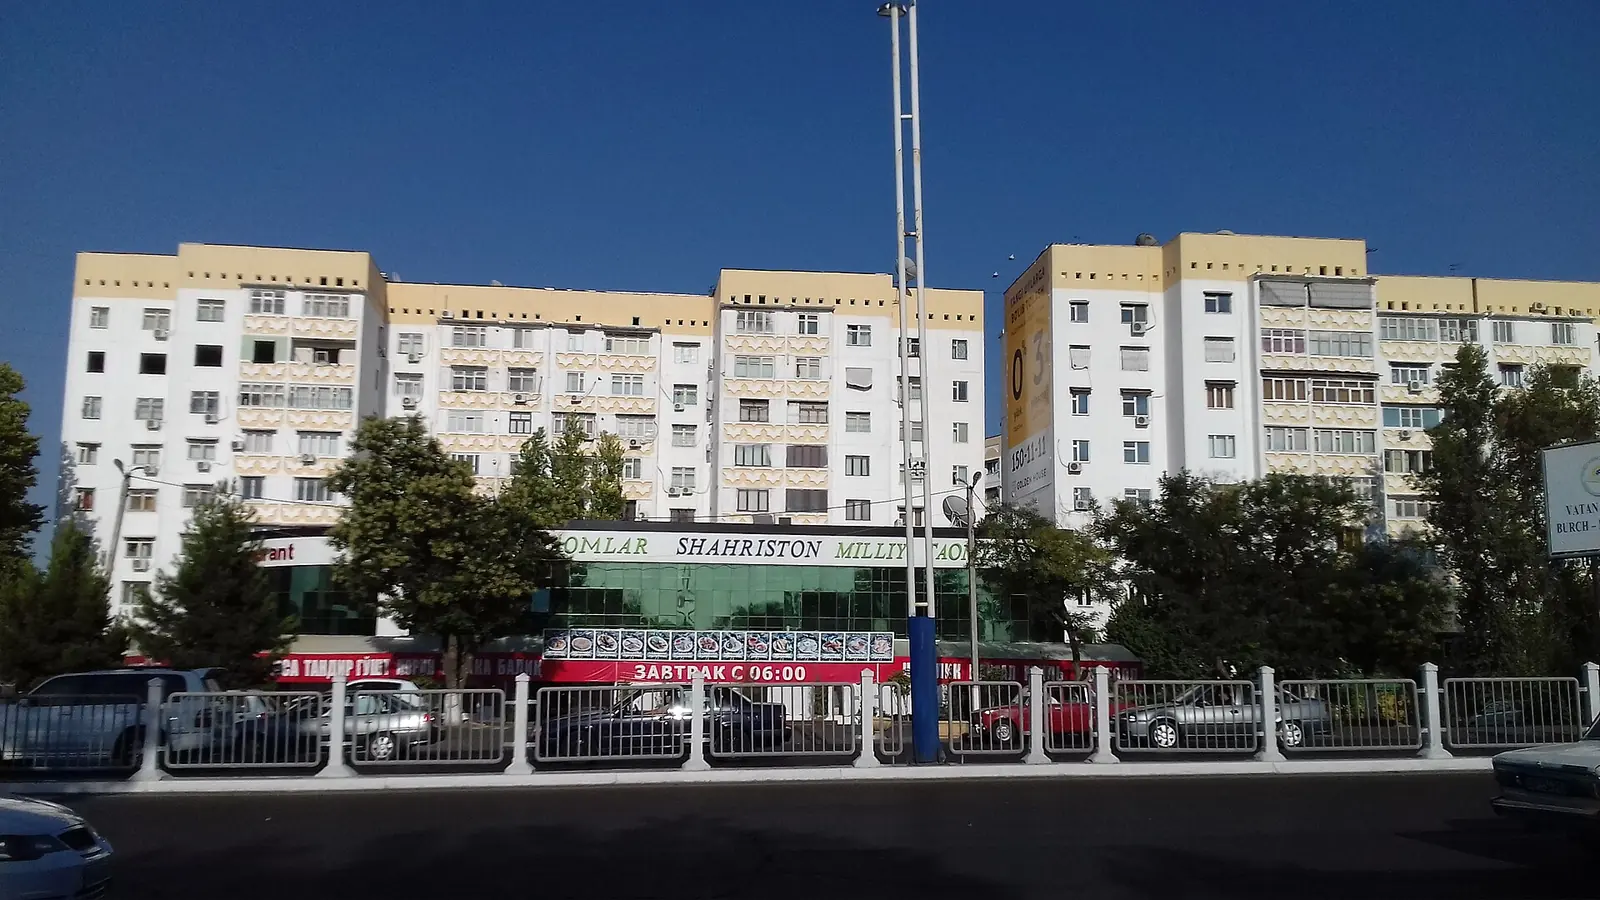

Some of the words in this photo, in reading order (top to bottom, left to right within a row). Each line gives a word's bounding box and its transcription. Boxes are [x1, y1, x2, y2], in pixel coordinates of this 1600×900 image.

[1016, 475, 1032, 491] GOLDEN
[1566, 502, 1599, 516] VATAN
[1557, 520, 1589, 534] BURCH
[560, 536, 648, 555] OMLAR
[676, 537, 823, 558] SHAHRISTON
[834, 542, 907, 560] MILLIY
[634, 664, 725, 681] ЗАВТРАК
[750, 665, 806, 682] 06:00
